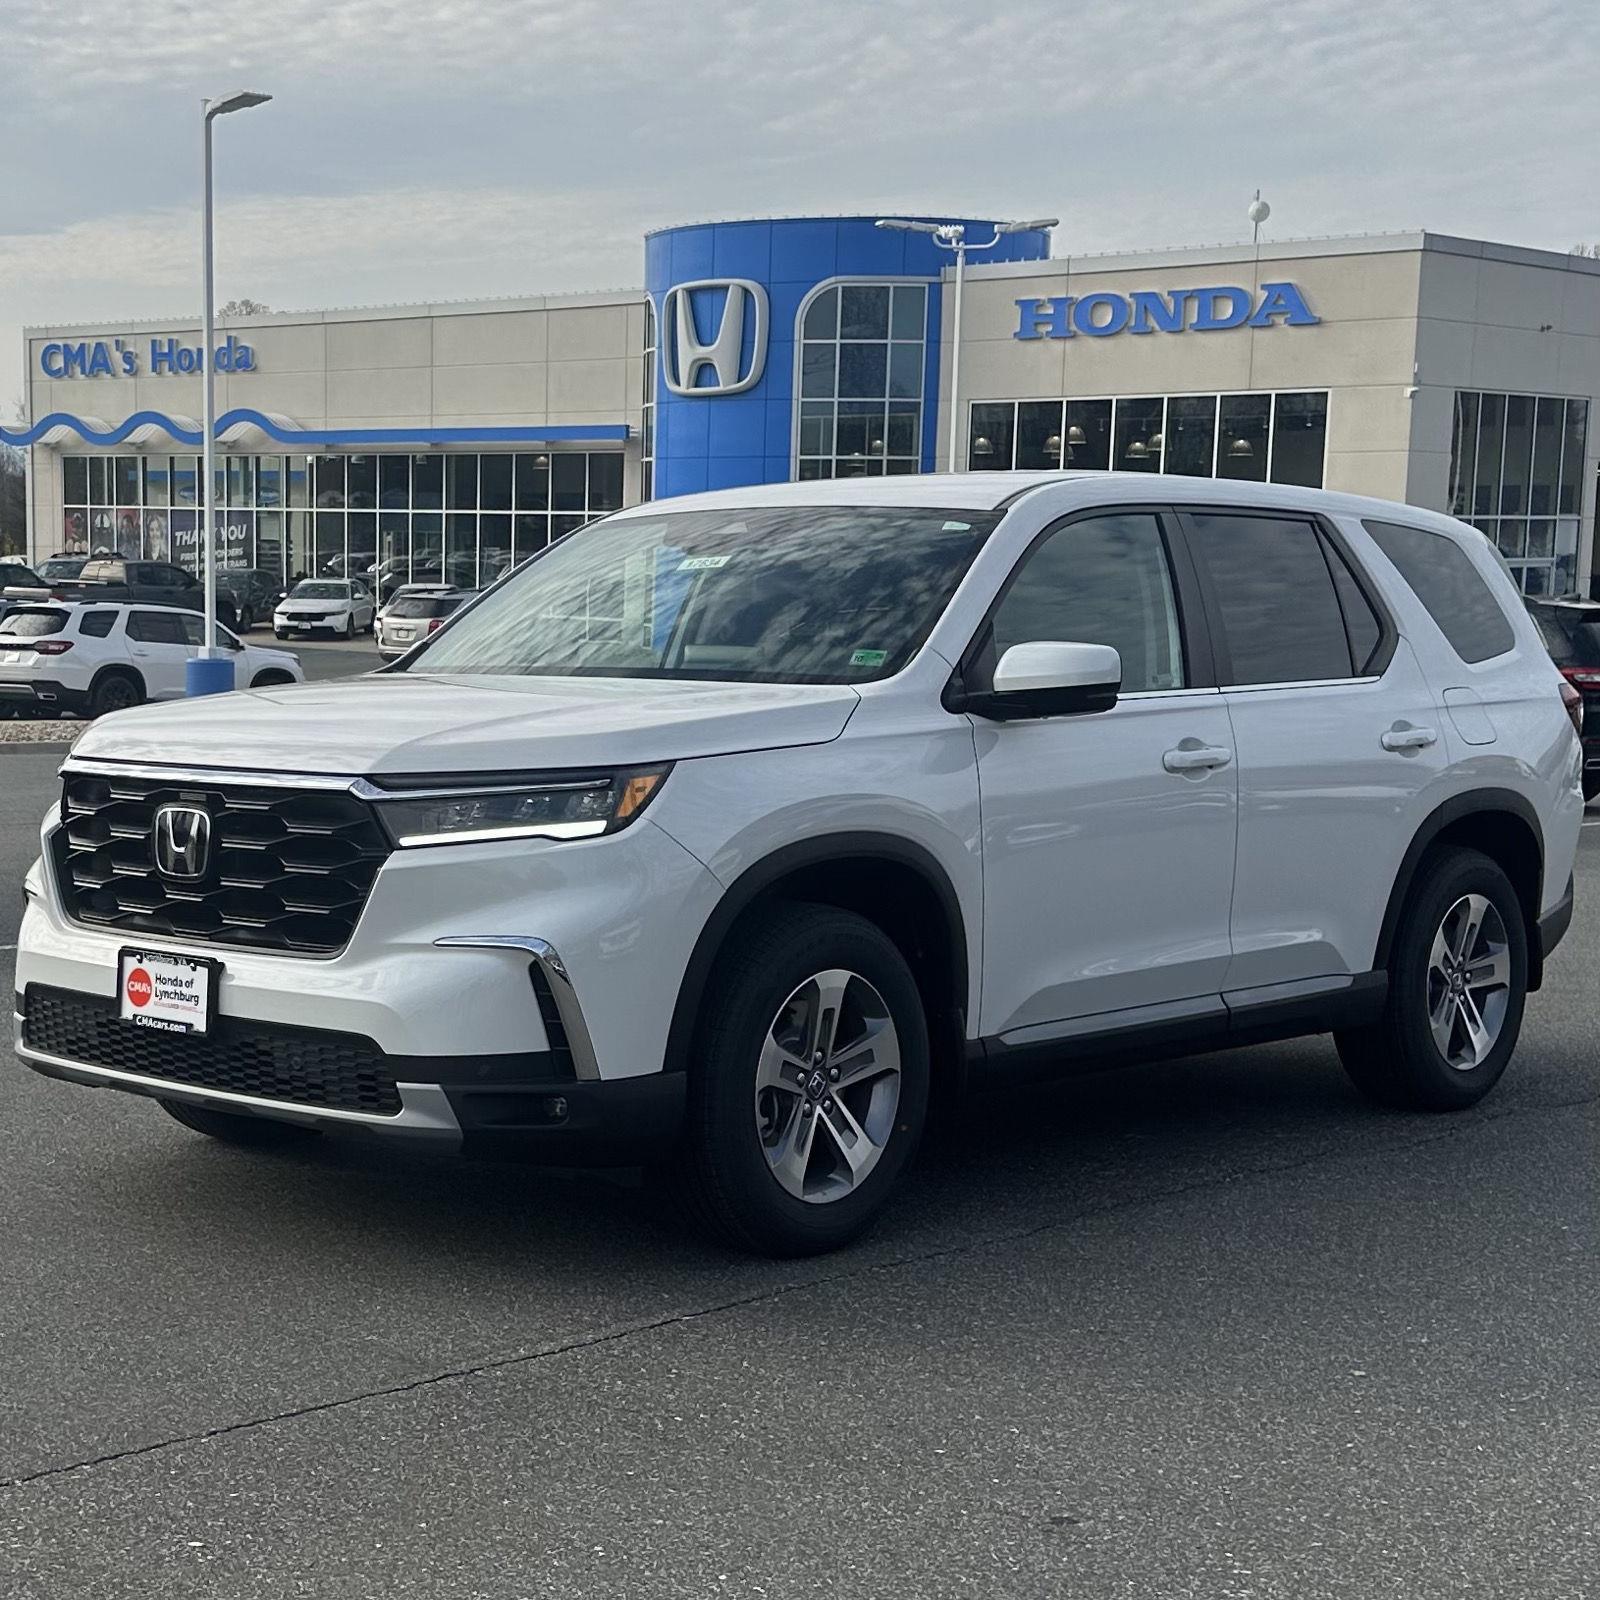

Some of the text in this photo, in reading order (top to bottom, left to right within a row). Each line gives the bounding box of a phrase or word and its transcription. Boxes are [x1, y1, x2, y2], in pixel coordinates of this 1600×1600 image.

[1013, 282, 1320, 339] HONDA
[41, 339, 137, 378] CMA's
[175, 524, 247, 546] THAN YOU
[128, 981, 151, 993] CMA's
[155, 973, 194, 988] Honda of
[155, 987, 199, 1006] Lynchburg
[136, 1016, 187, 1033] CMAcars.com
